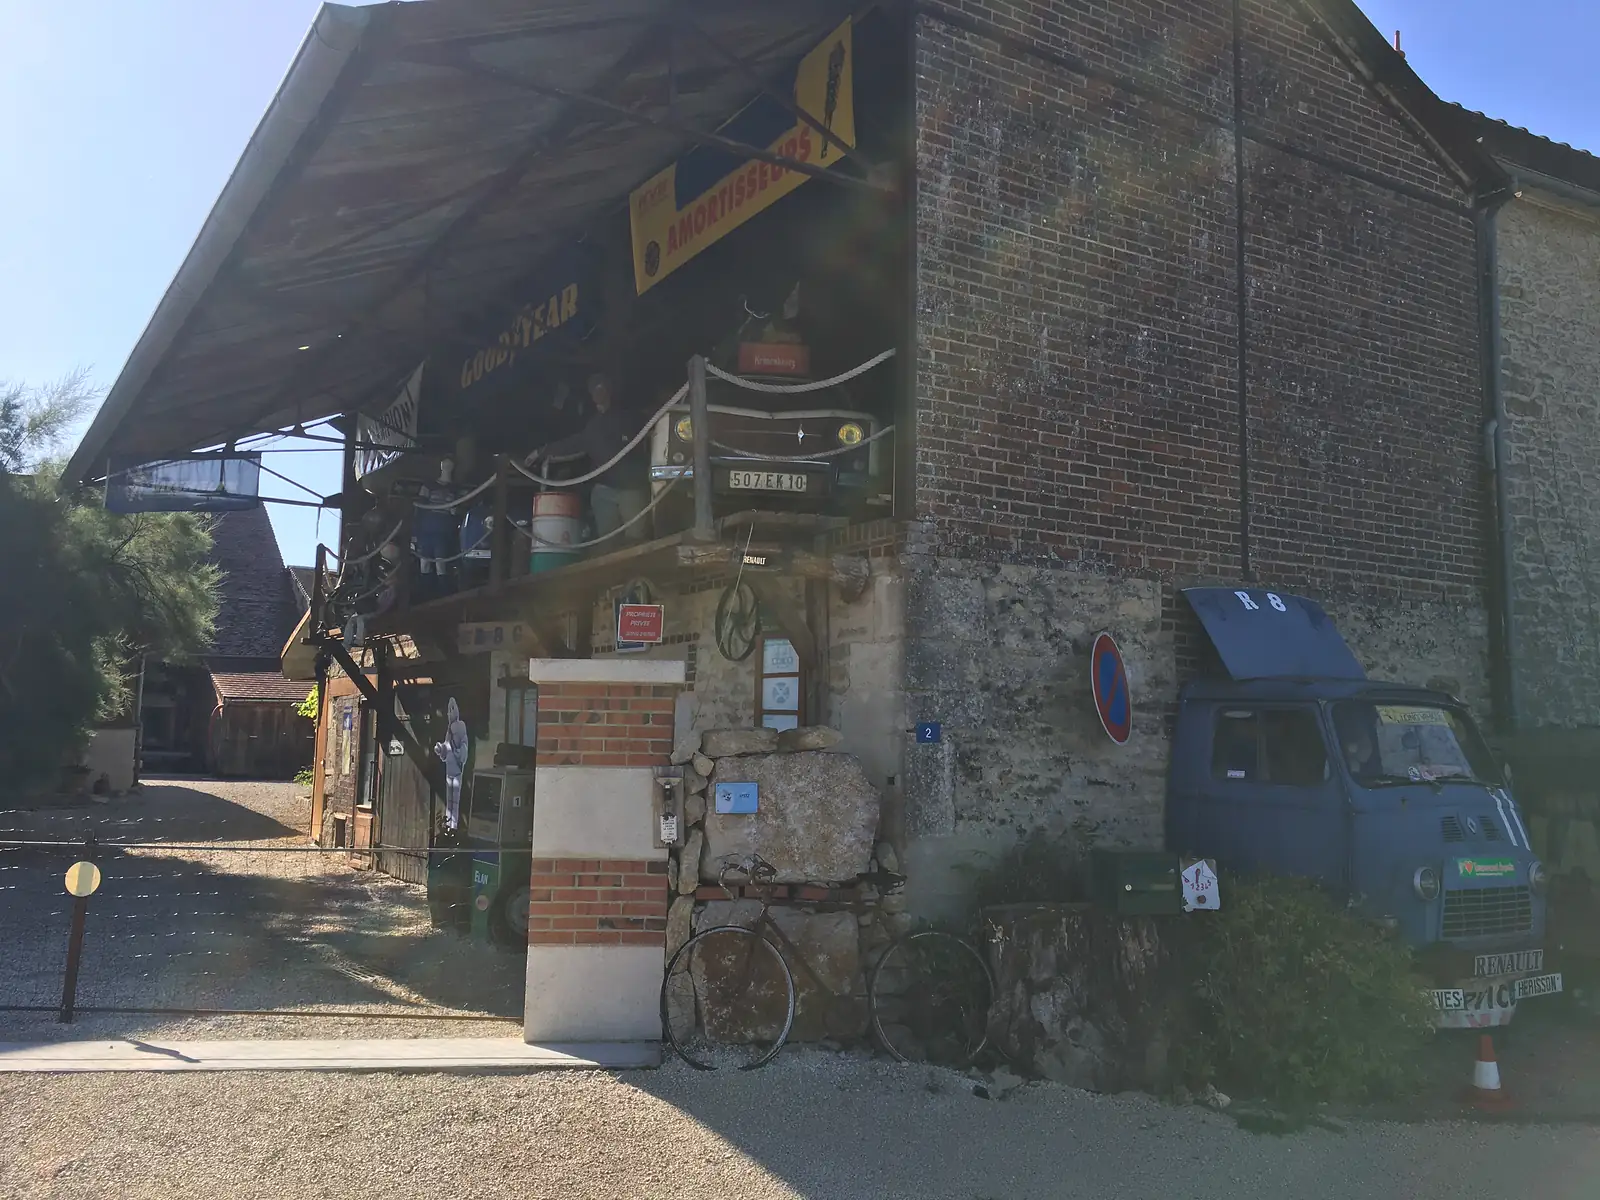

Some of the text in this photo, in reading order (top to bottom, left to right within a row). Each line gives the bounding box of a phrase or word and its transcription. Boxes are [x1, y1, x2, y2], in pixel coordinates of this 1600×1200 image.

[925, 727, 932, 739] 2
[1475, 950, 1543, 977] RENAULT
[1518, 975, 1558, 997] HERISSON
